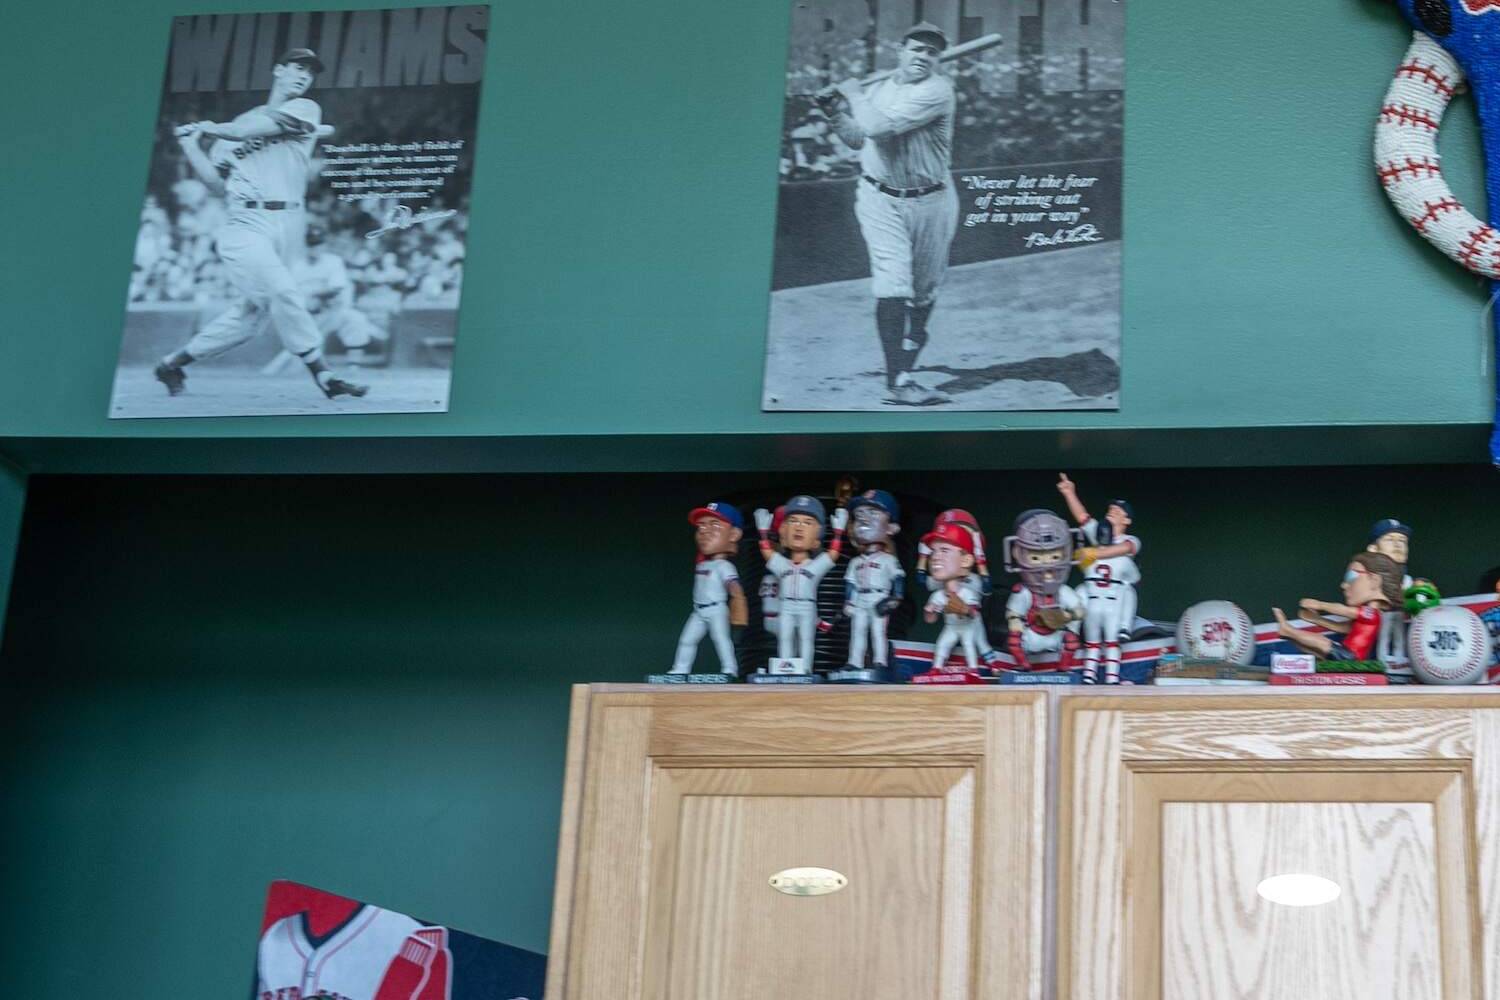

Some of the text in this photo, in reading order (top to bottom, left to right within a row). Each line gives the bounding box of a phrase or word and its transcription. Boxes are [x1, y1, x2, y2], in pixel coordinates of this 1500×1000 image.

[380, 142, 397, 152] the
[399, 141, 422, 152] only
[423, 140, 450, 150] field
[362, 166, 391, 176] three
[391, 166, 422, 175] times
[422, 166, 441, 174] out
[350, 178, 371, 188] and
[385, 176, 444, 187] considered
[1016, 174, 1038, 189] let
[1038, 174, 1063, 188] the
[1062, 174, 1098, 191] fear
[974, 191, 1082, 209] of striking out
[964, 211, 990, 227] get
[991, 208, 1008, 223] in
[1008, 211, 1047, 226] your
